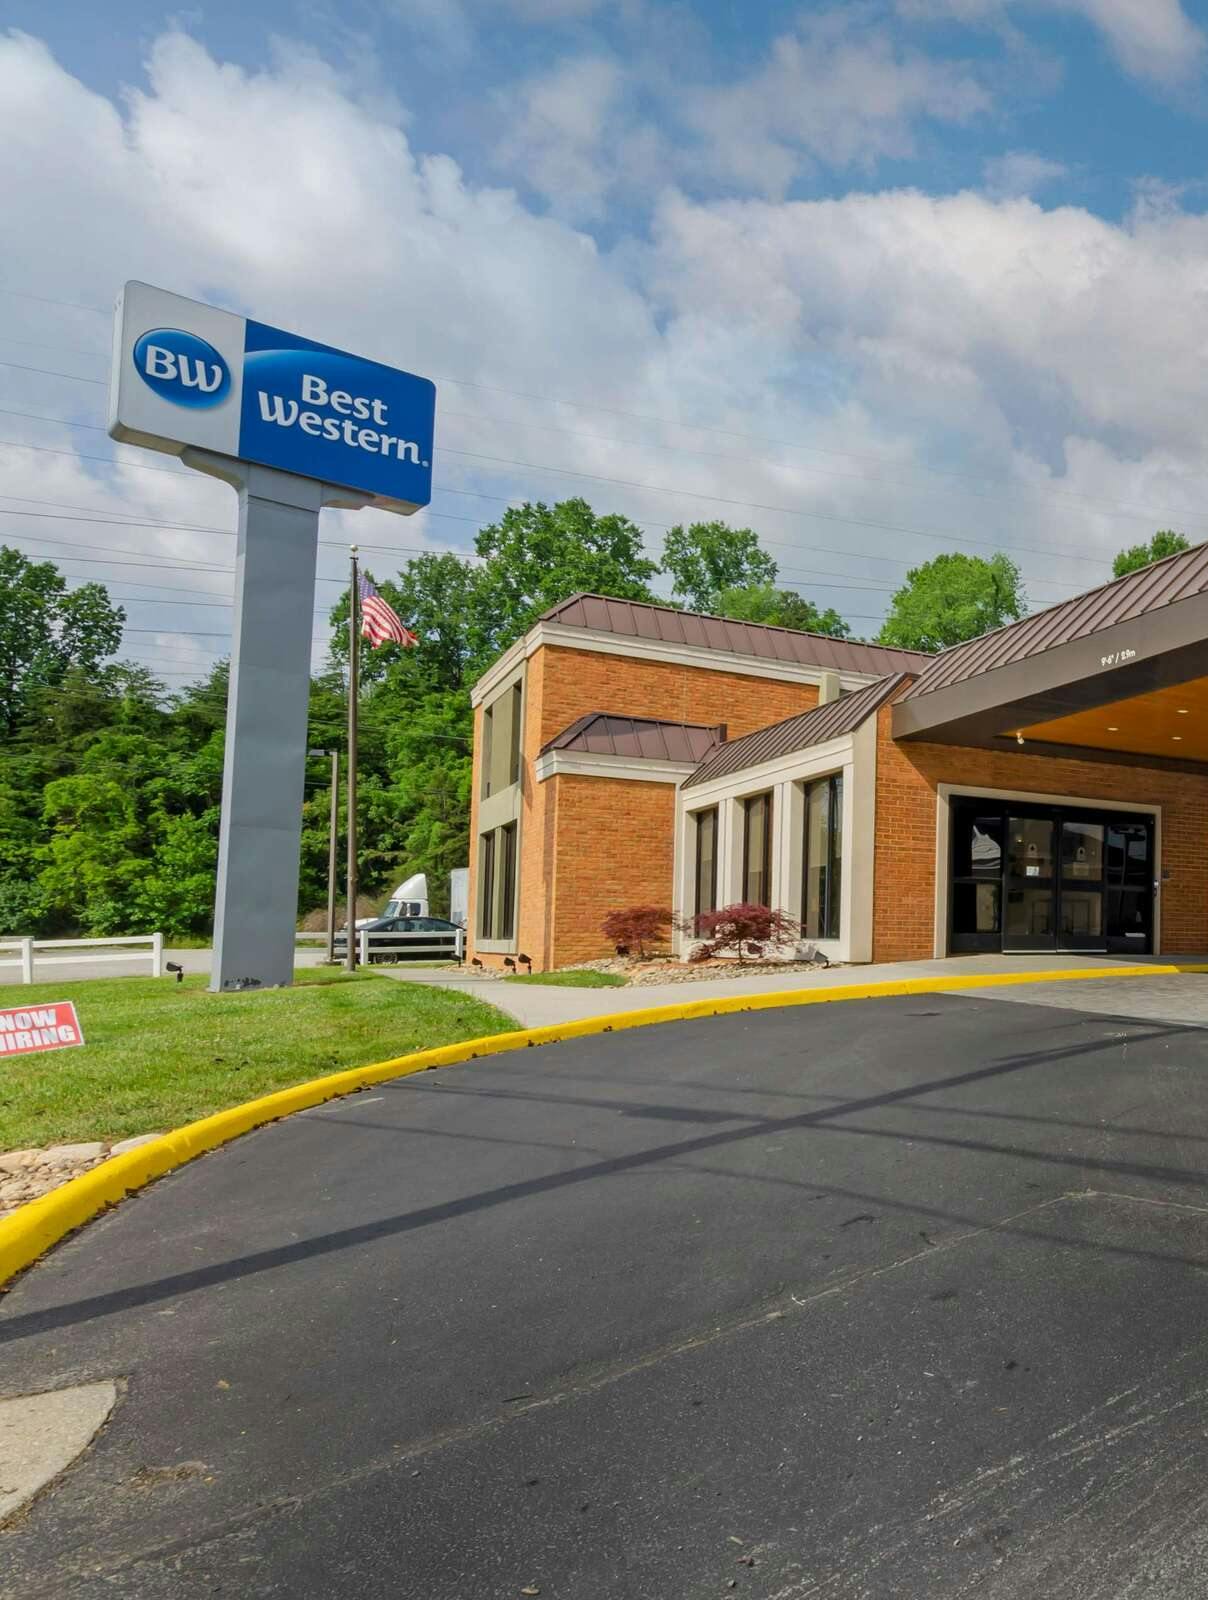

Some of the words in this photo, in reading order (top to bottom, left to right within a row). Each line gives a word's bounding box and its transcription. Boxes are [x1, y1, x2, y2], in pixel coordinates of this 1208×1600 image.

[145, 344, 223, 393] BW
[302, 373, 388, 426] Best
[0, 1009, 57, 1033] NOW
